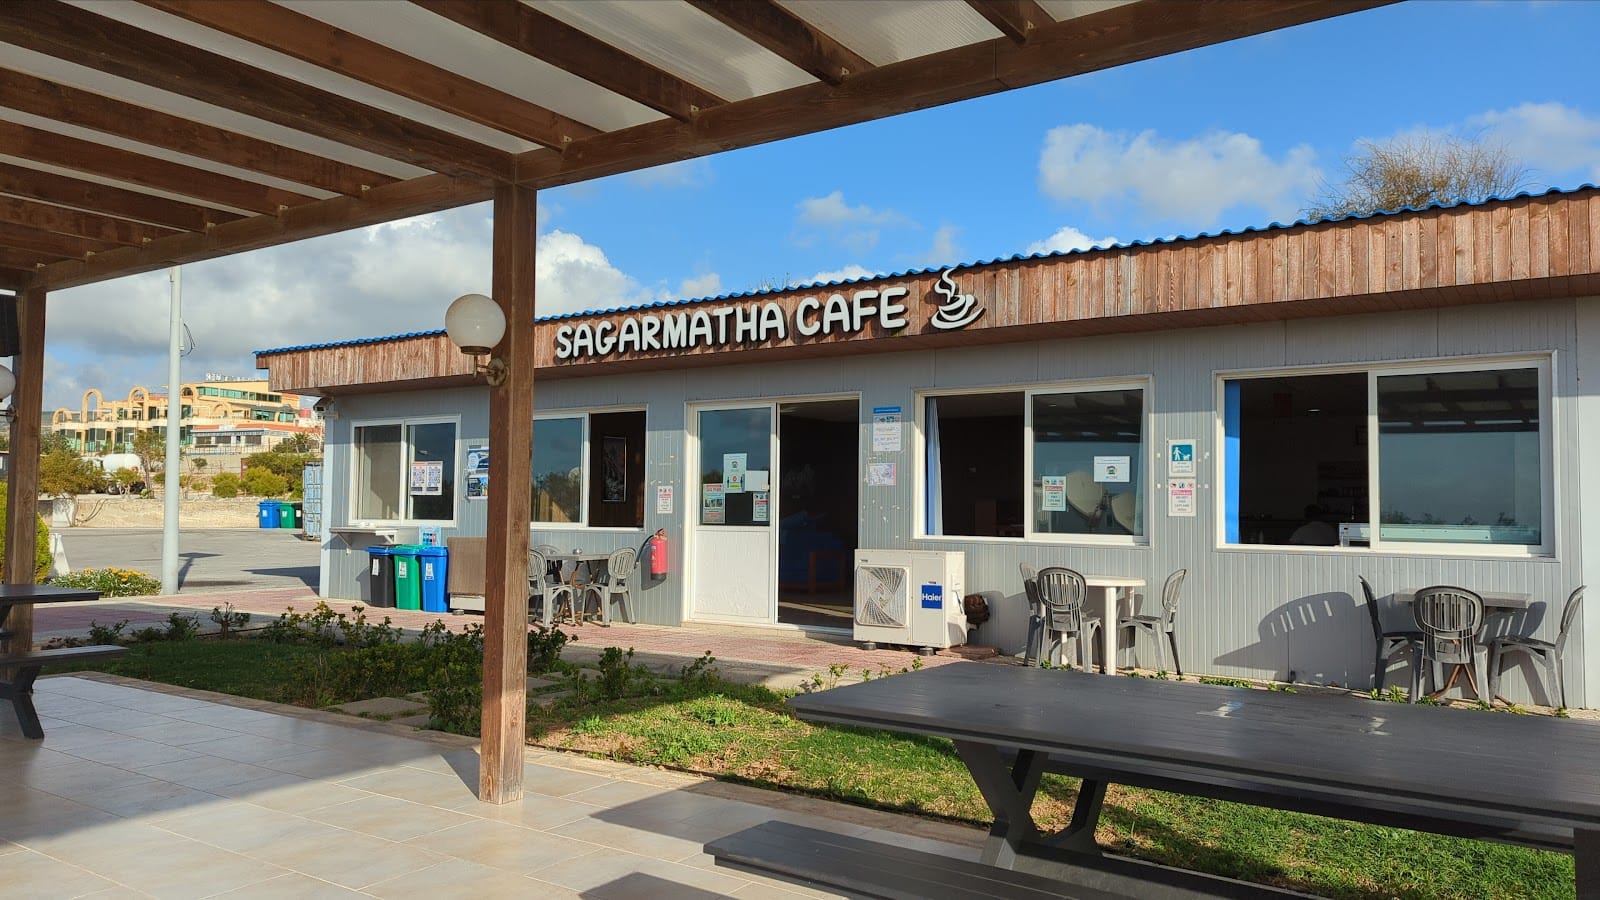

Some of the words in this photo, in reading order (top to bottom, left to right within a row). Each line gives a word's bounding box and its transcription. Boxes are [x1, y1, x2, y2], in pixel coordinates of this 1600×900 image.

[556, 303, 785, 359] SAGARMATHA
[796, 287, 907, 336] CAFE
[921, 593, 942, 602] Haier
